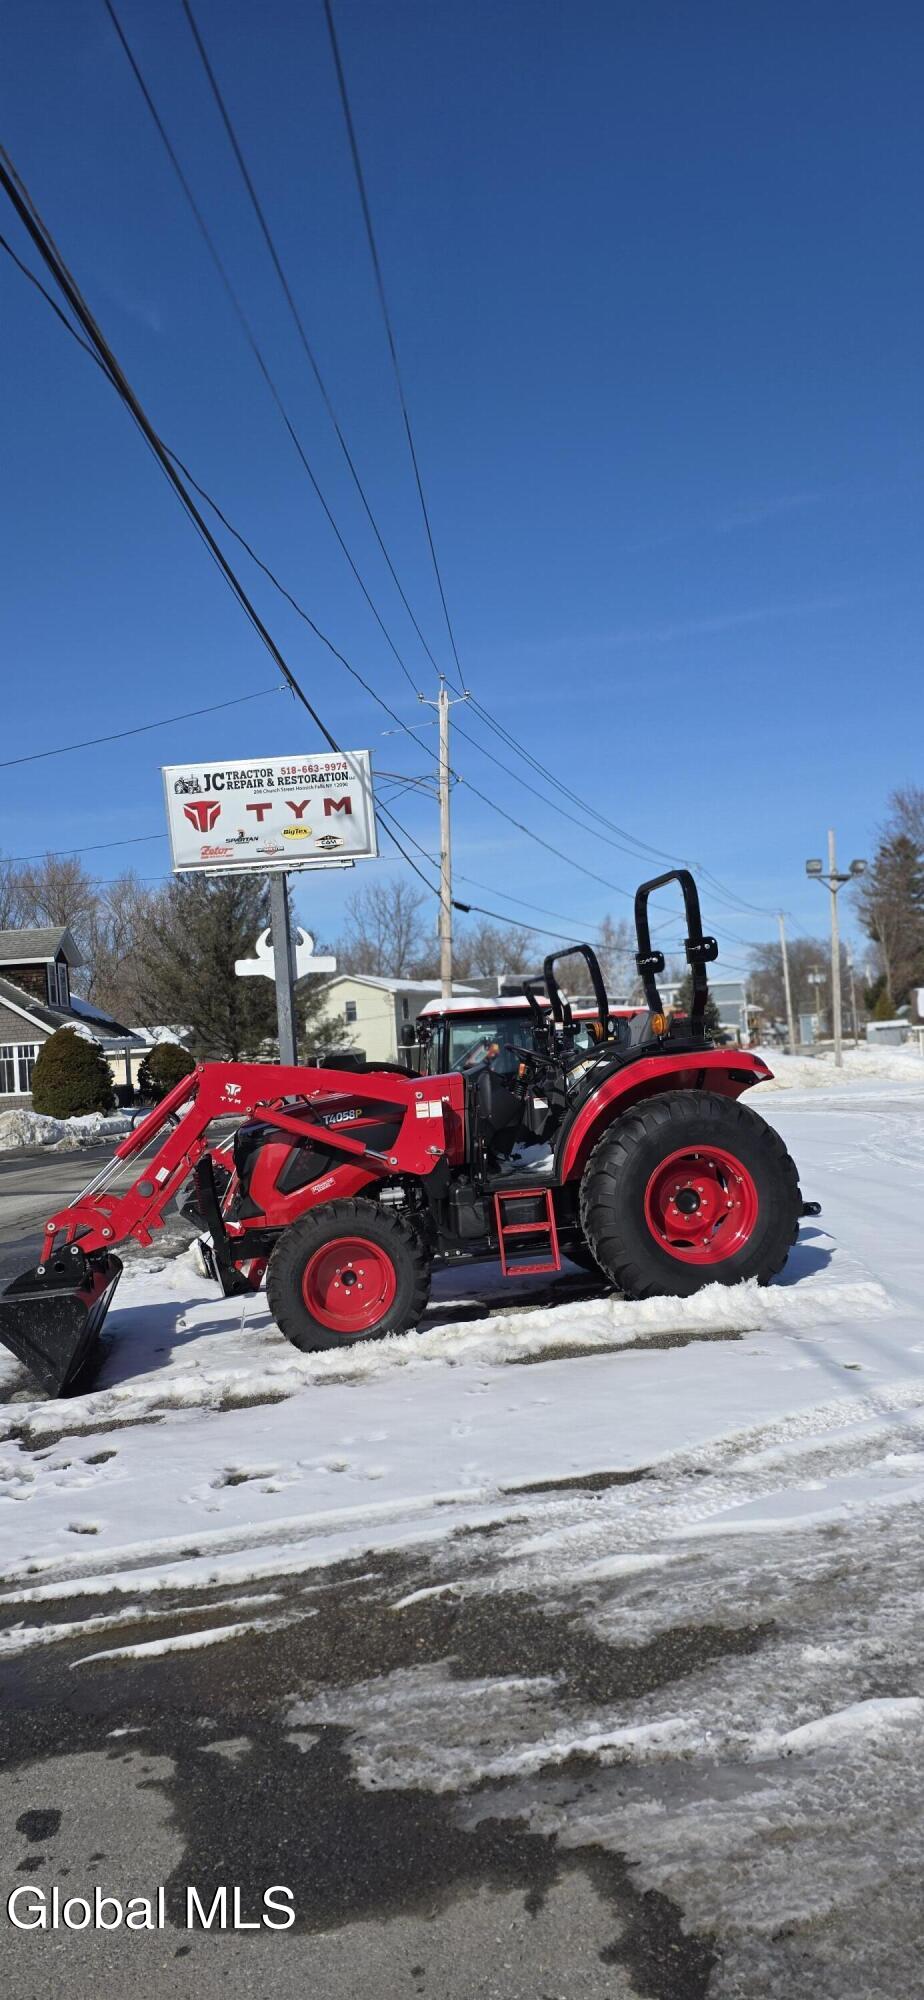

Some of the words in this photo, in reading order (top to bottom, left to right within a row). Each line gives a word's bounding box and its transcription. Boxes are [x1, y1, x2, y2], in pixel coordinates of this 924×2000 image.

[226, 768, 274, 780] TRACTOR
[280, 762, 348, 775] 518-663-9974
[204, 772, 225, 792] JC
[226, 778, 265, 791] REPAIR
[266, 777, 275, 787] &
[277, 771, 349, 786] RESTORATION
[246, 796, 352, 822] TYM
[200, 845, 234, 855] Zetor
[219, 1096, 241, 1104] TYM
[322, 1109, 362, 1125] T4058P
